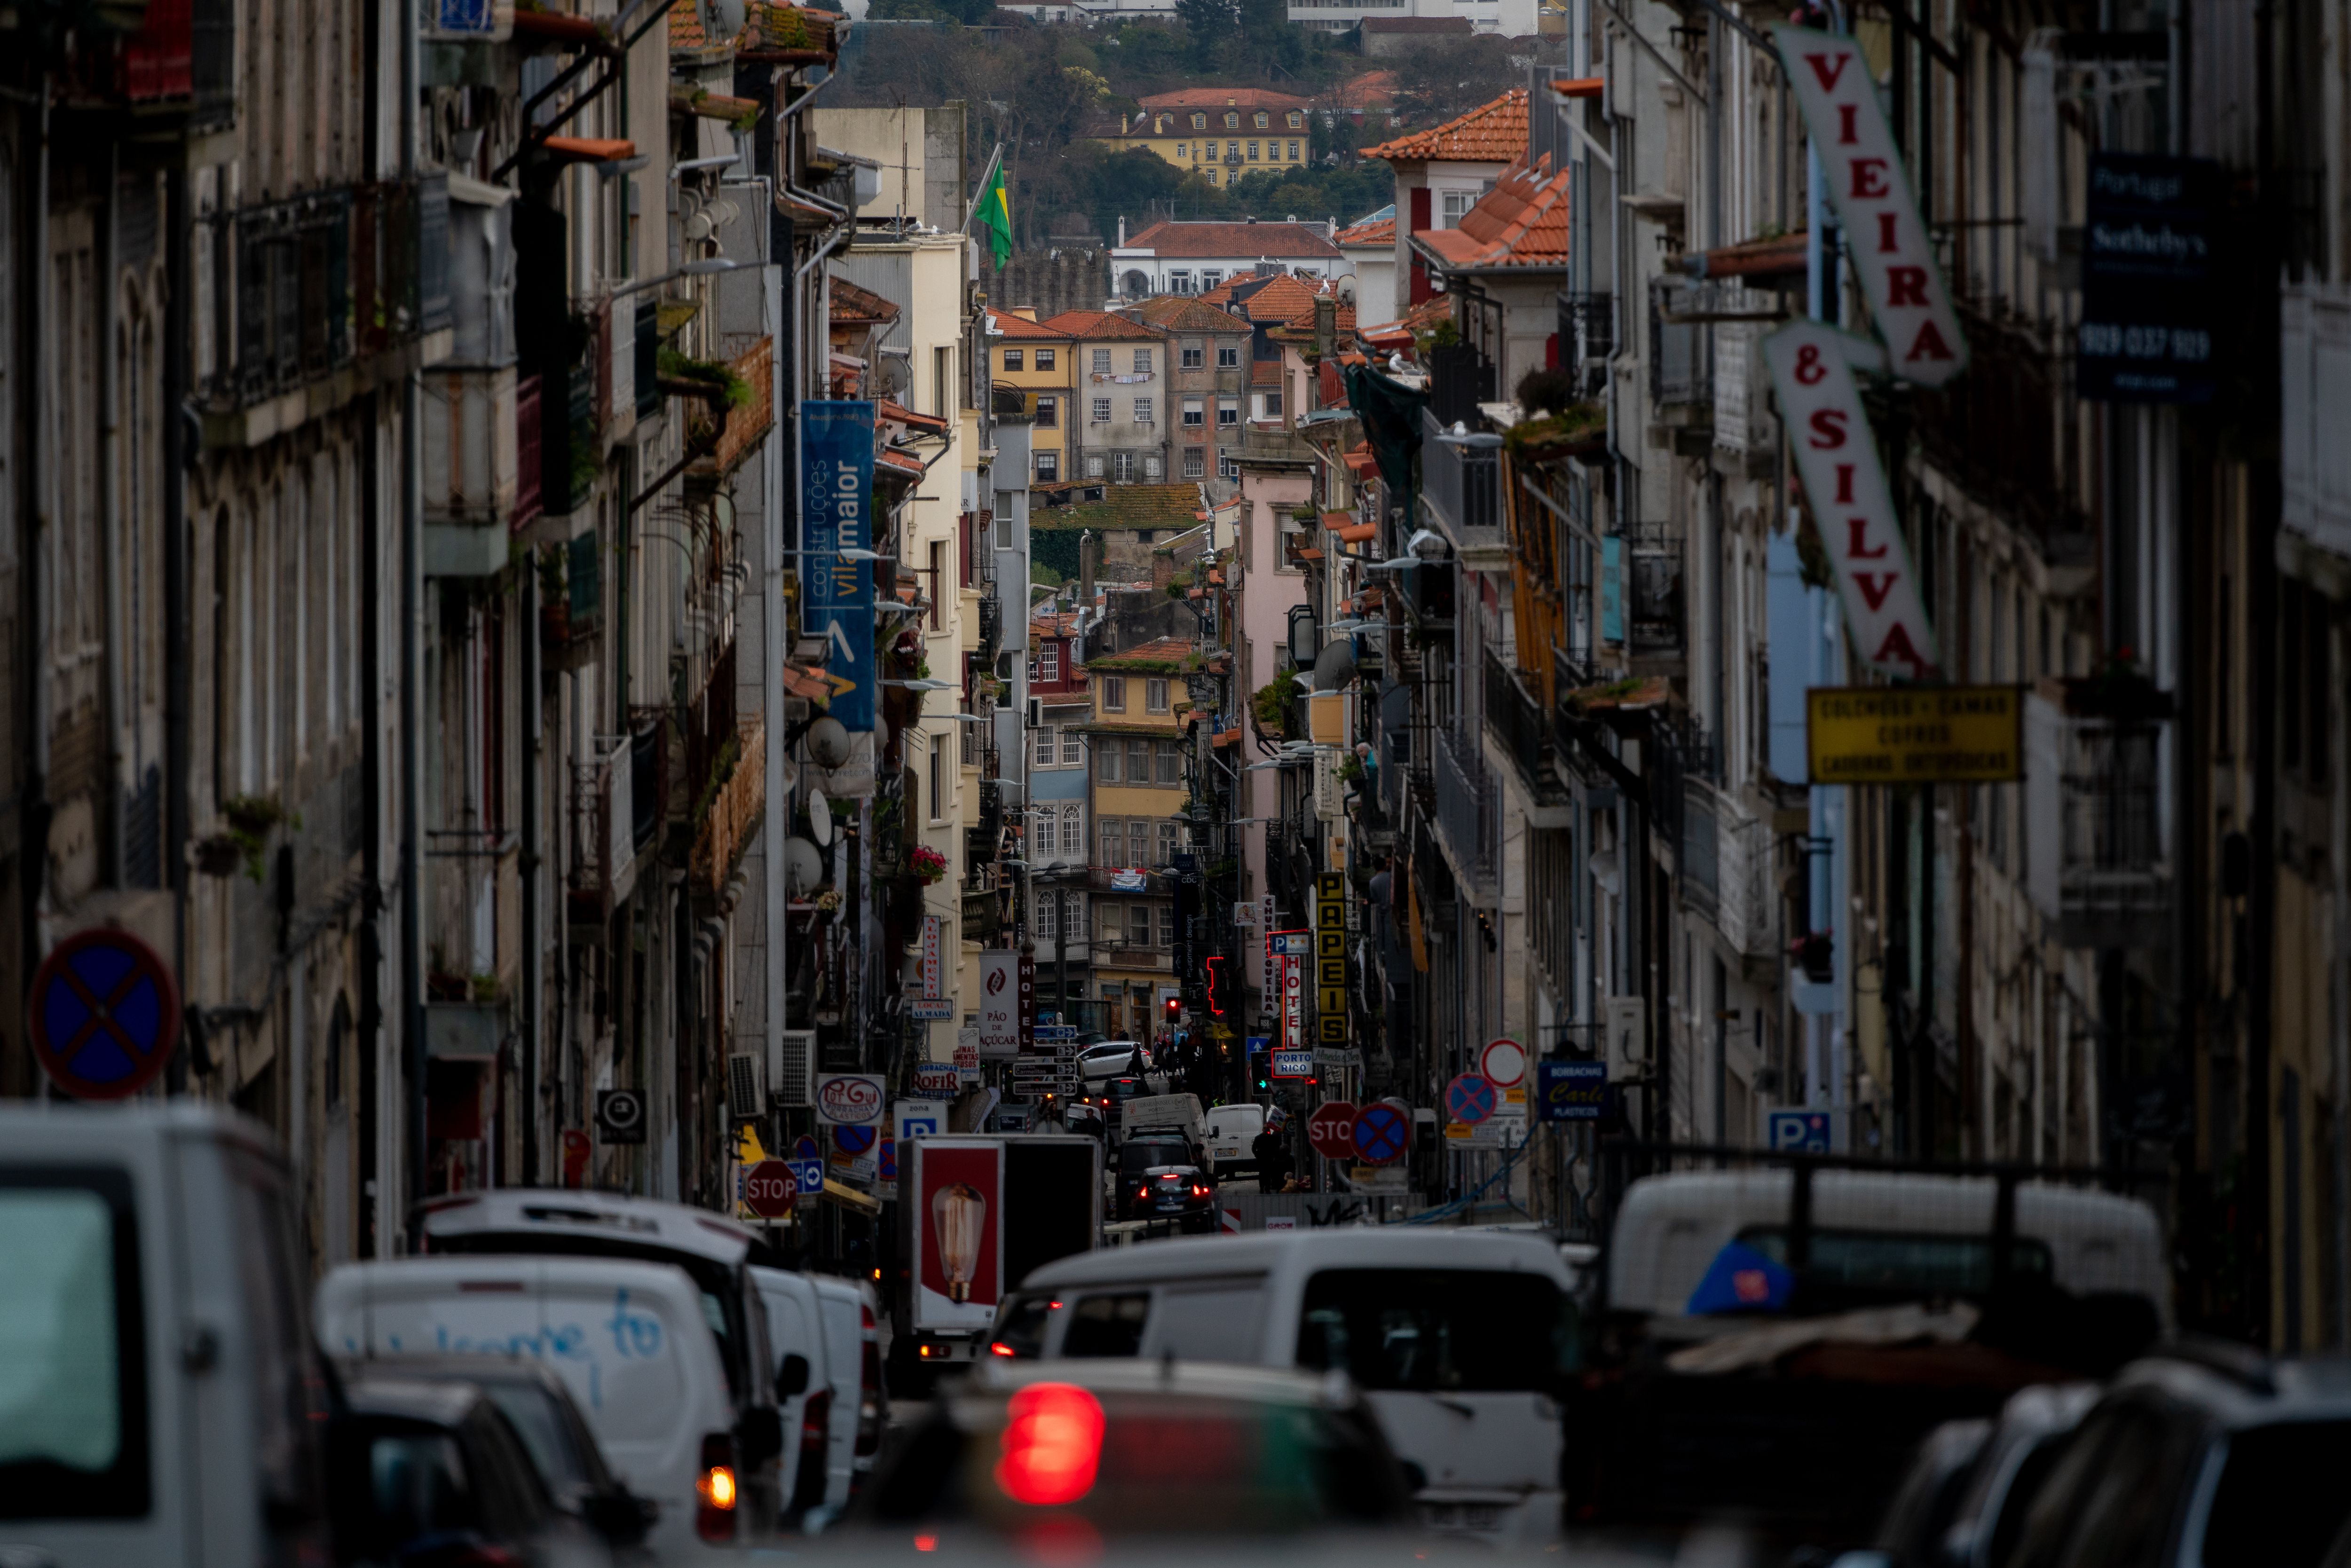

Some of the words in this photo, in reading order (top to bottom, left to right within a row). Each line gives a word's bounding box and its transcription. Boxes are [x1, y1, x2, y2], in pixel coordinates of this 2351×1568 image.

[2094, 169, 2183, 201] Portugal
[1805, 53, 1952, 362] VIEIRA
[2091, 222, 2208, 262] Sotheby's
[1795, 346, 1826, 385] &
[807, 460, 830, 597] construções
[1809, 410, 1927, 678] SILVA
[1877, 723, 1949, 744] COFRES
[927, 917, 937, 999] ALOJAMENTO
[1321, 877, 1343, 1039] PAPEIS
[987, 1010, 1007, 1022] PÃO
[1021, 965, 1032, 1043] HOTEL
[1287, 956, 1299, 1047] HOTEL
[979, 1034, 1017, 1047] AÇÚCAR
[1313, 1049, 1341, 1062] Almeida
[1311, 1120, 1351, 1141] STO
[749, 1178, 796, 1199] STOP
